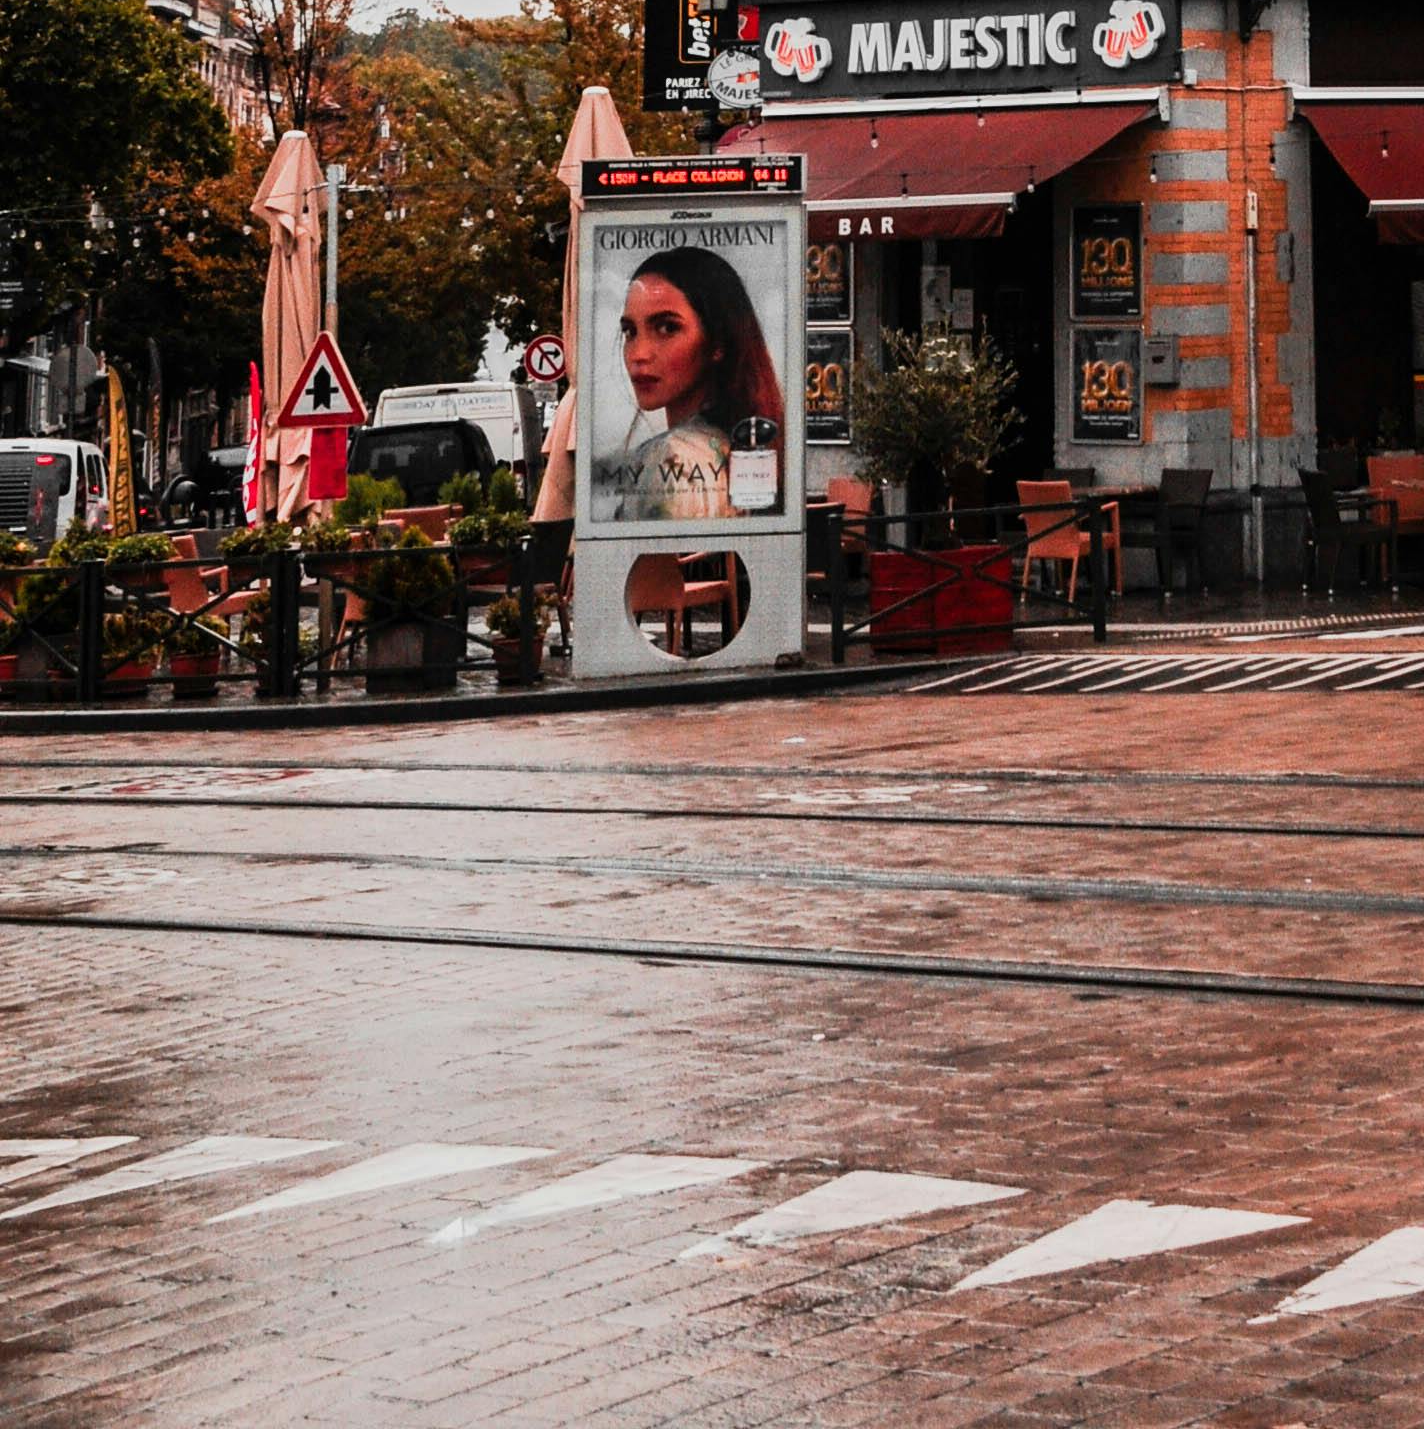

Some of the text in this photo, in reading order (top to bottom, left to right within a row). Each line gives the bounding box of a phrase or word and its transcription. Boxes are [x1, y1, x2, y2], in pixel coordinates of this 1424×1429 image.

[848, 10, 1076, 74] MAJESTIC
[665, 77, 701, 88] PARIEZ
[716, 81, 761, 100] MAJES
[665, 89, 711, 100] EN DIREC
[652, 171, 688, 184] PLACE
[690, 169, 746, 183] COLIGNON
[838, 216, 894, 235] BAR
[600, 225, 774, 250] GIORGIO ARMANI
[1081, 237, 1134, 274] 130
[1081, 360, 1134, 397] 130
[601, 461, 725, 486] MY WAY
